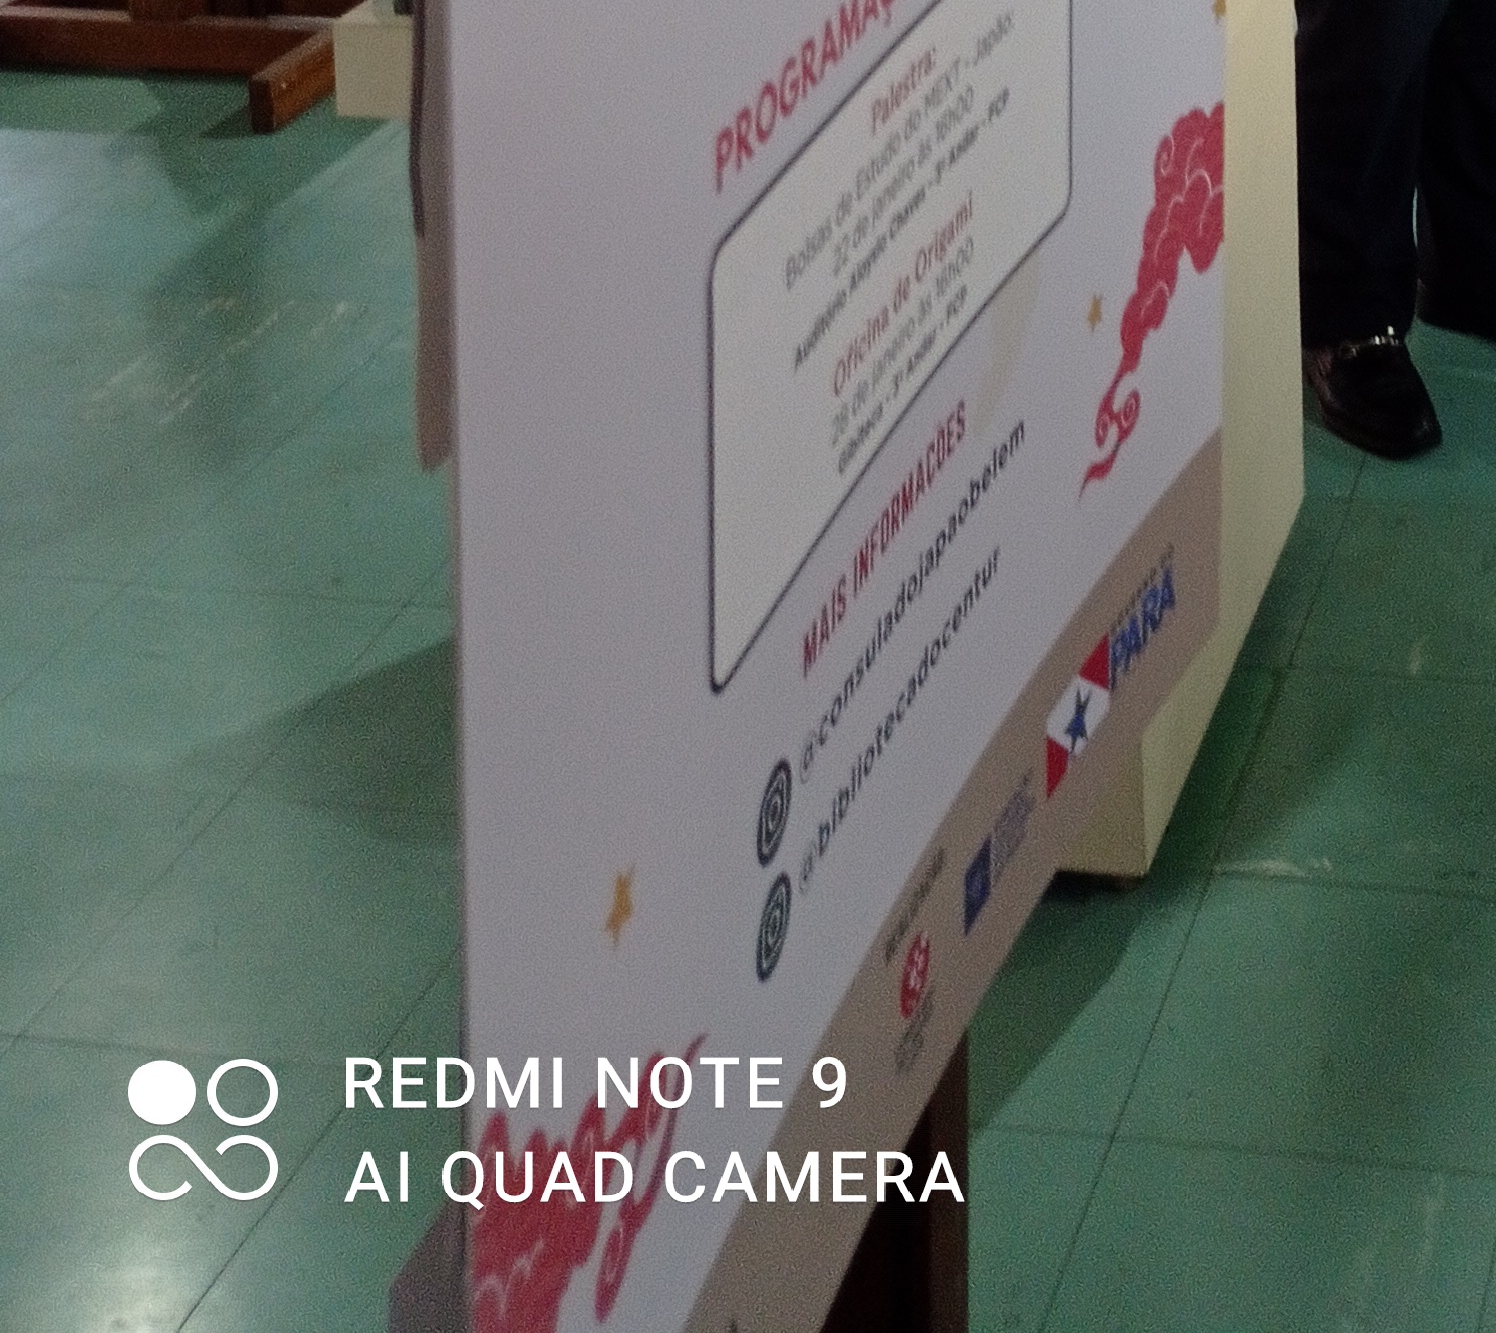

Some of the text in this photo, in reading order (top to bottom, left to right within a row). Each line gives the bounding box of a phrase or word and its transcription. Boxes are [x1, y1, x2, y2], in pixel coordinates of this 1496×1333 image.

[833, 187, 973, 398] Oficina de Origami
[803, 398, 967, 678] MAIS INFORMAÇÕES
